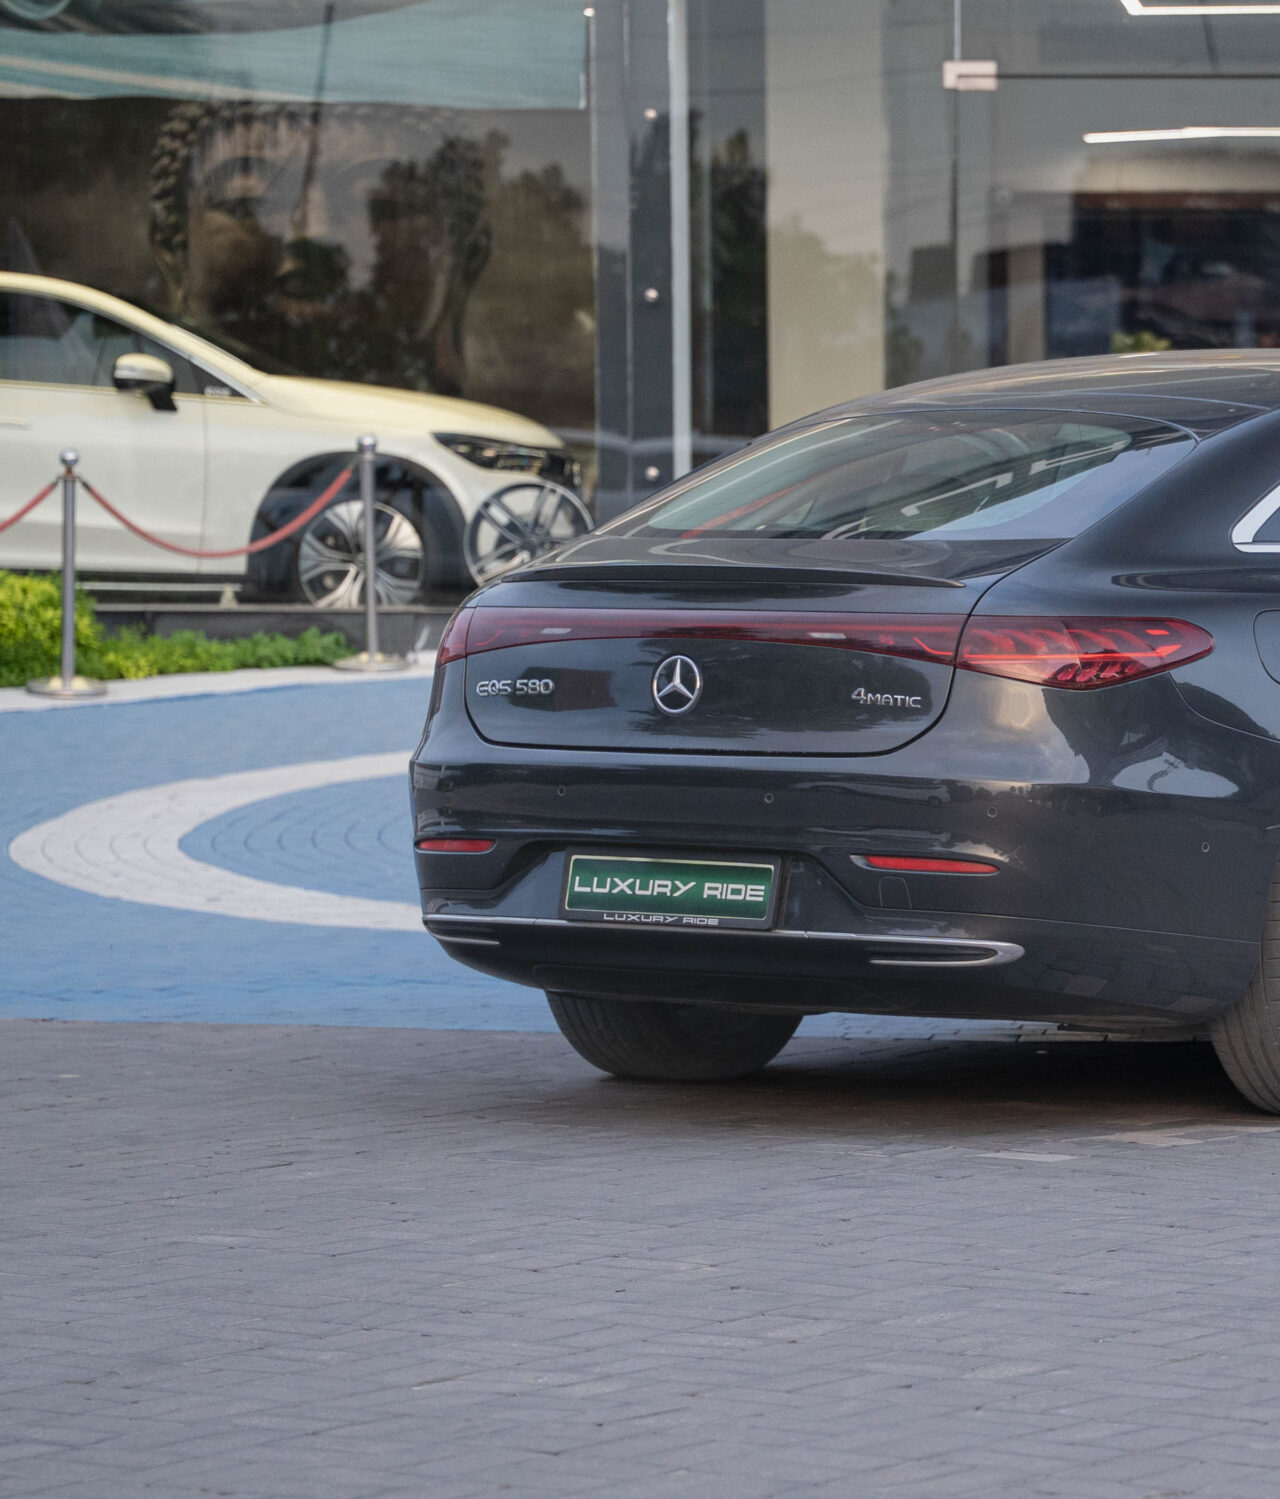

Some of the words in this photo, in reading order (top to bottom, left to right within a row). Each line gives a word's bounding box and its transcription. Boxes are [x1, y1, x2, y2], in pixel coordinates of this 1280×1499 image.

[476, 680, 512, 696] EQS
[515, 679, 555, 694] 580
[851, 688, 922, 708] 4MATIC
[573, 876, 697, 897] LUXURY
[703, 882, 766, 901] RIDE
[603, 913, 679, 924] LUXURY
[682, 917, 719, 926] RIDE
